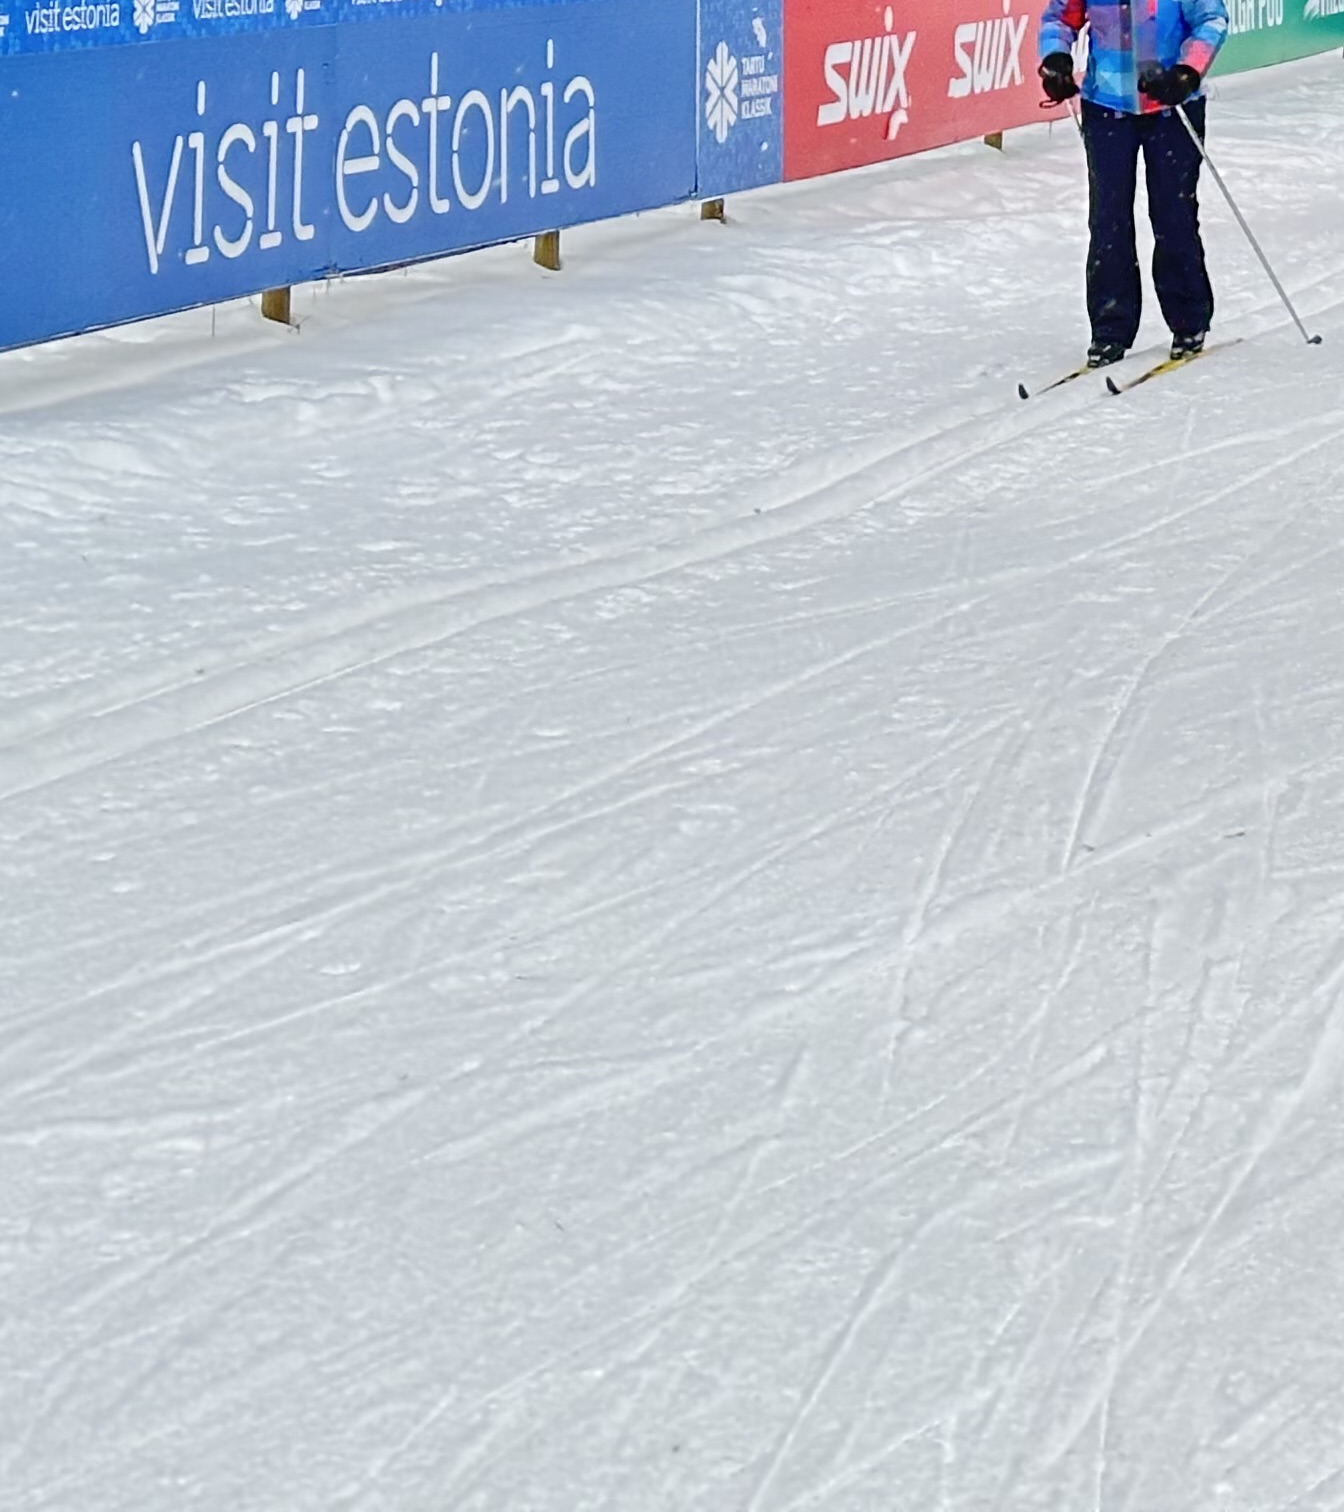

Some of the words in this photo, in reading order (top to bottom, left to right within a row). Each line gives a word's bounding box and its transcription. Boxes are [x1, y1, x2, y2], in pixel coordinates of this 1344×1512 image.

[25, 0, 61, 35] visit
[132, 68, 319, 275] visit
[335, 38, 597, 232] estonia
